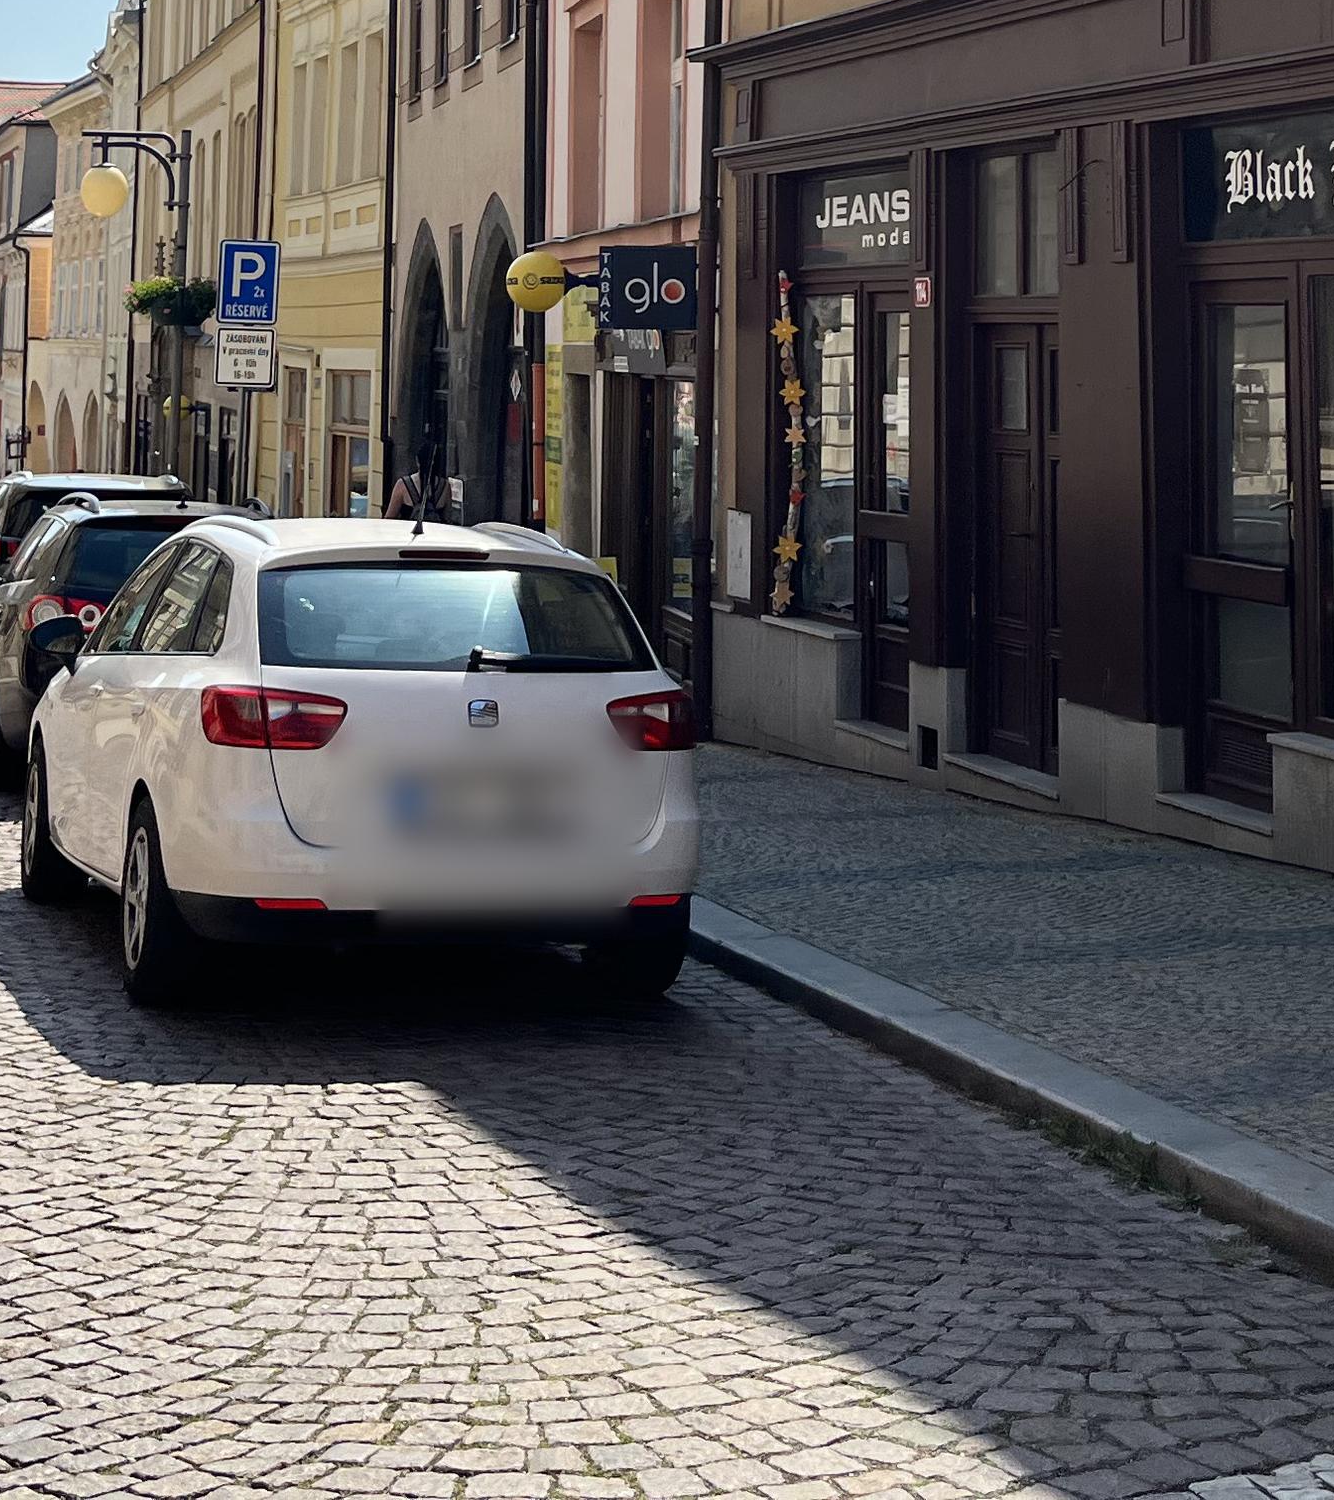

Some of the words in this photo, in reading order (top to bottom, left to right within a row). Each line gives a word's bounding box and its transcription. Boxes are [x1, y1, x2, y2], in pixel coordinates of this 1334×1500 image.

[1224, 145, 1316, 213] Black
[815, 189, 910, 229] JEANS
[861, 227, 910, 248] moda
[231, 251, 266, 298] P
[253, 285, 265, 298] 2x
[599, 252, 612, 323] TABÁK
[624, 261, 686, 314] glo
[225, 301, 269, 318] RÉSERVÉ
